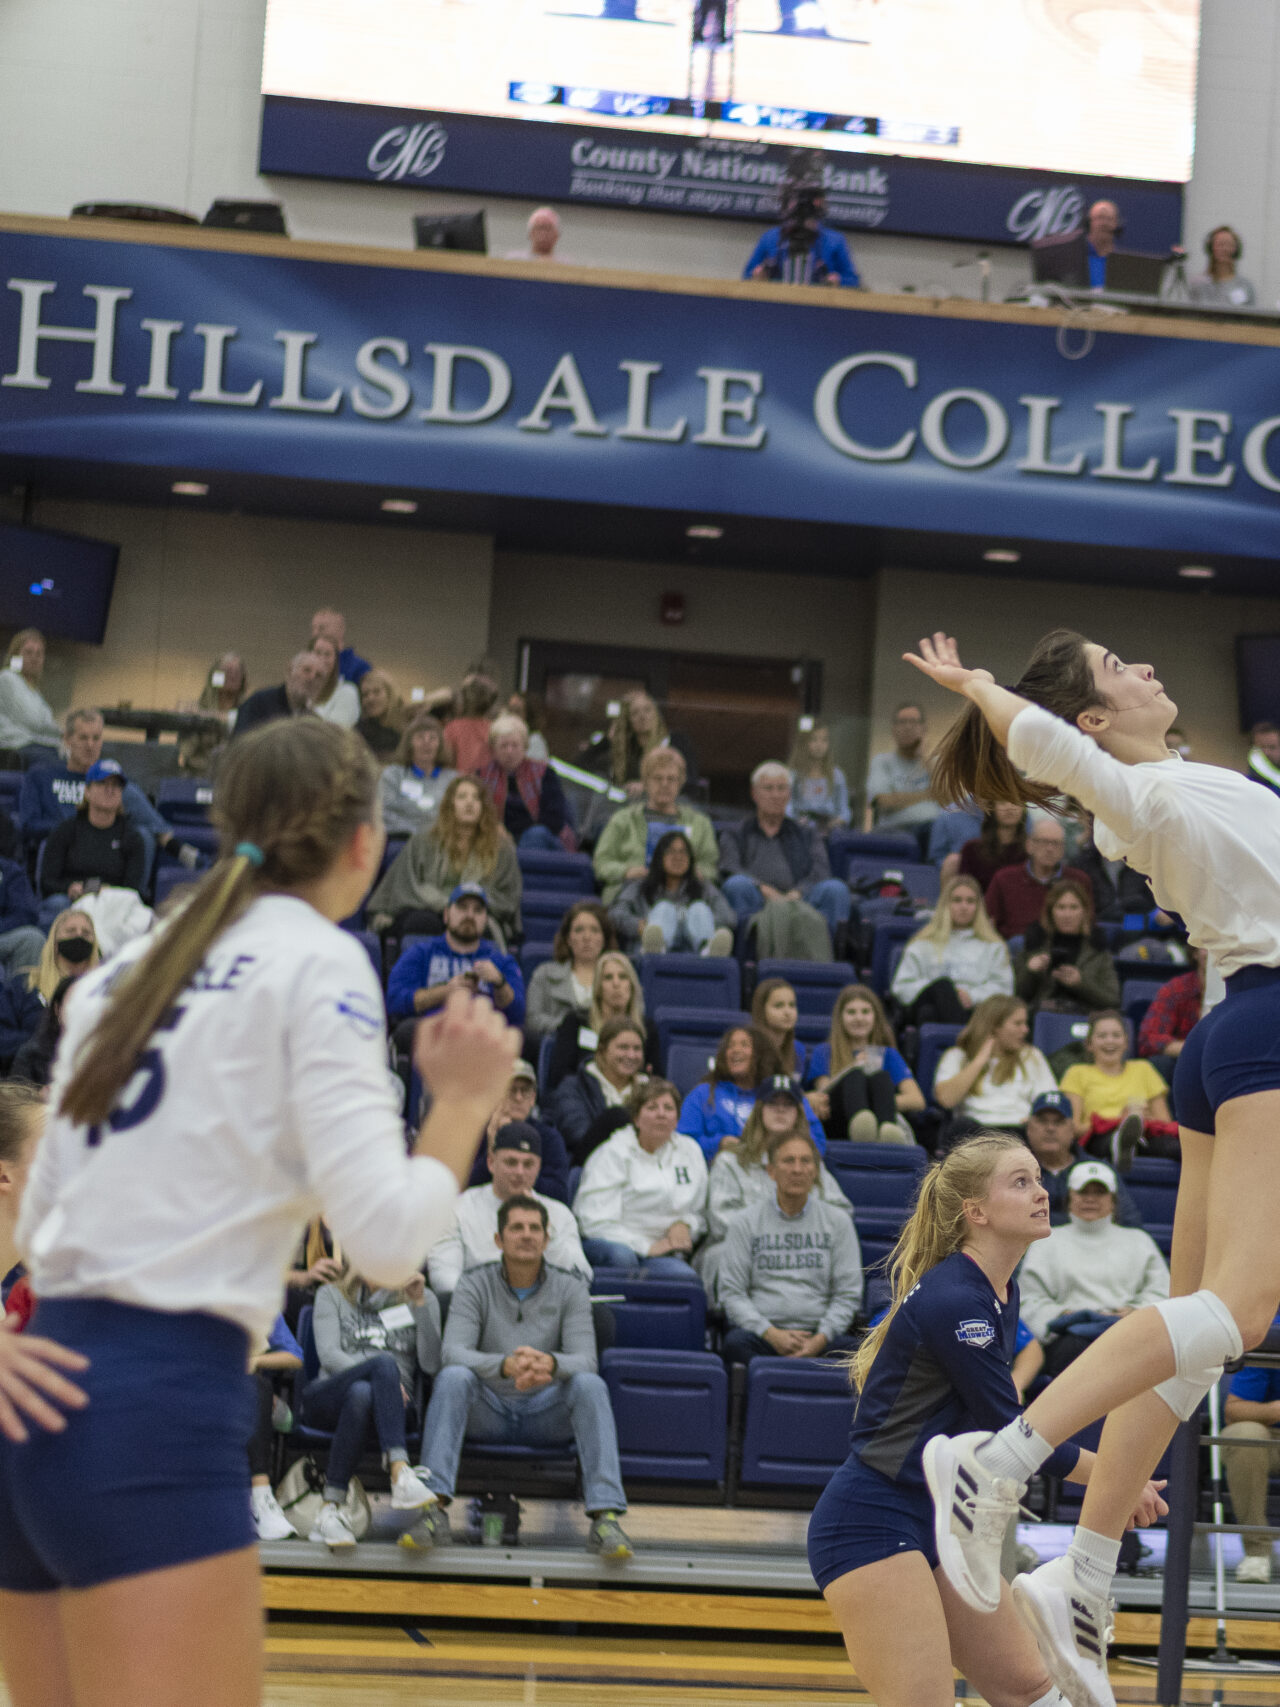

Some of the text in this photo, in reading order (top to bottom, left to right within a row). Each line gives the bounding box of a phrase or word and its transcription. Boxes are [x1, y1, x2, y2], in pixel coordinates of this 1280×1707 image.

[571, 137, 676, 180] County
[681, 149, 788, 185] Nationa
[823, 163, 888, 195] ank
[675, 1166, 691, 1185] H
[752, 1233, 832, 1253] HILLSDALE
[757, 1253, 824, 1270] COLLEGE
